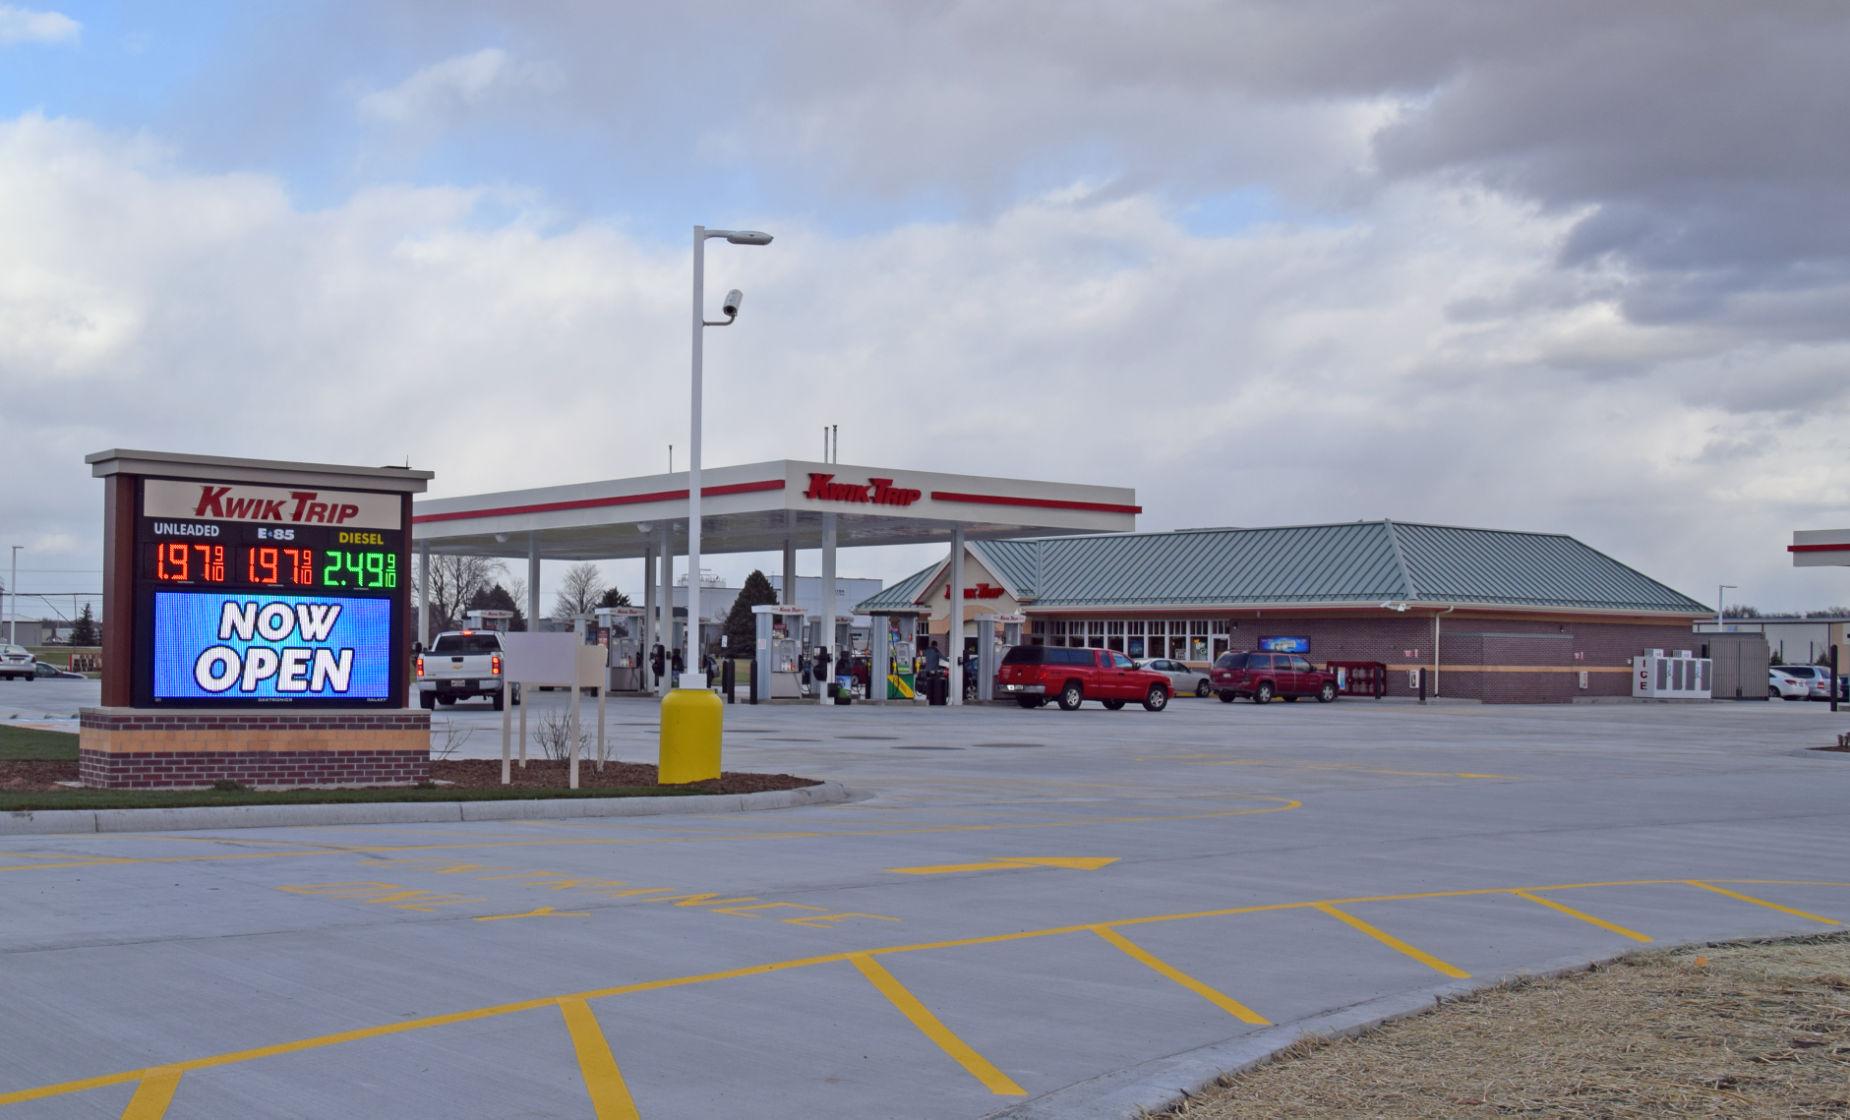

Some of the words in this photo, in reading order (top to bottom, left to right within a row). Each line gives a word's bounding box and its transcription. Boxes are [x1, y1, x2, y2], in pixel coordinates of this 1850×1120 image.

[193, 485, 286, 521] KWIK
[289, 491, 359, 524] TRIP
[804, 473, 870, 504] KWIK
[869, 478, 922, 506] TRIP
[154, 523, 219, 537] UNLEADED
[339, 532, 384, 545] DIESEL
[219, 601, 342, 641] NOW
[194, 647, 354, 693] OPEN
[1640, 659, 1649, 690] ICE
